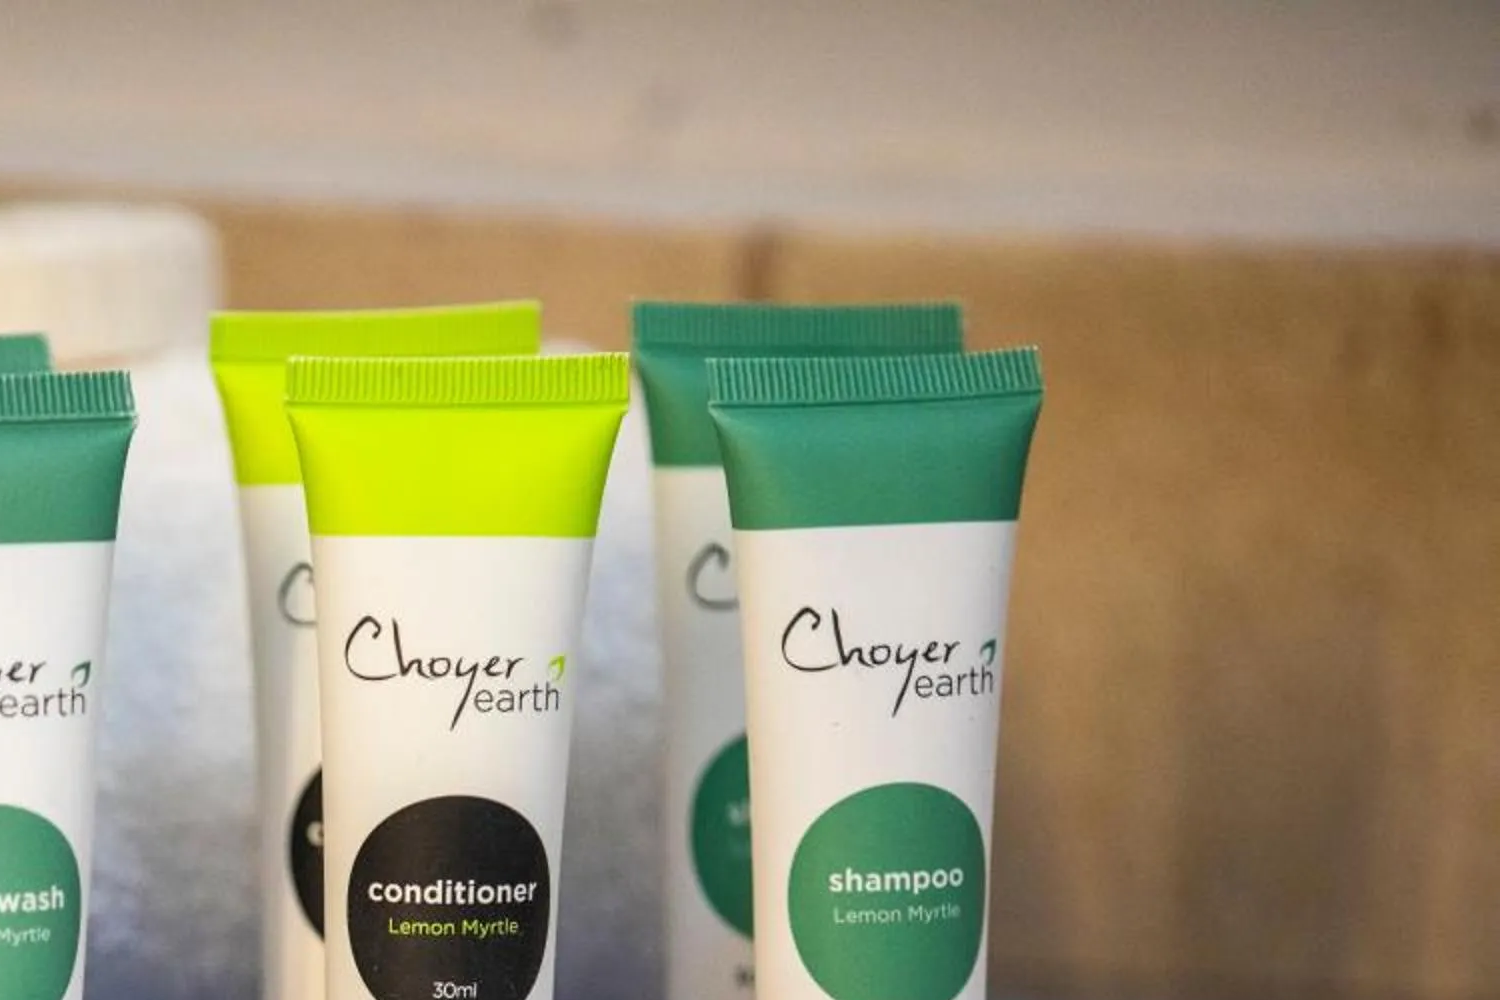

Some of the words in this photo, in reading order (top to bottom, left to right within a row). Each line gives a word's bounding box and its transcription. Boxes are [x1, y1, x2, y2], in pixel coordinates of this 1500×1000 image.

[345, 615, 524, 732] Choyer
[781, 606, 960, 717] Choyer
[914, 664, 994, 699] earth
[473, 681, 560, 713] earth
[368, 880, 537, 903] conditioner
[828, 867, 964, 894] shampoo
[833, 906, 901, 924] Lemon
[907, 902, 961, 925] Myrtle
[388, 918, 455, 935] Lemon
[461, 918, 519, 937] Myrtle
[432, 981, 477, 998] 30ml
